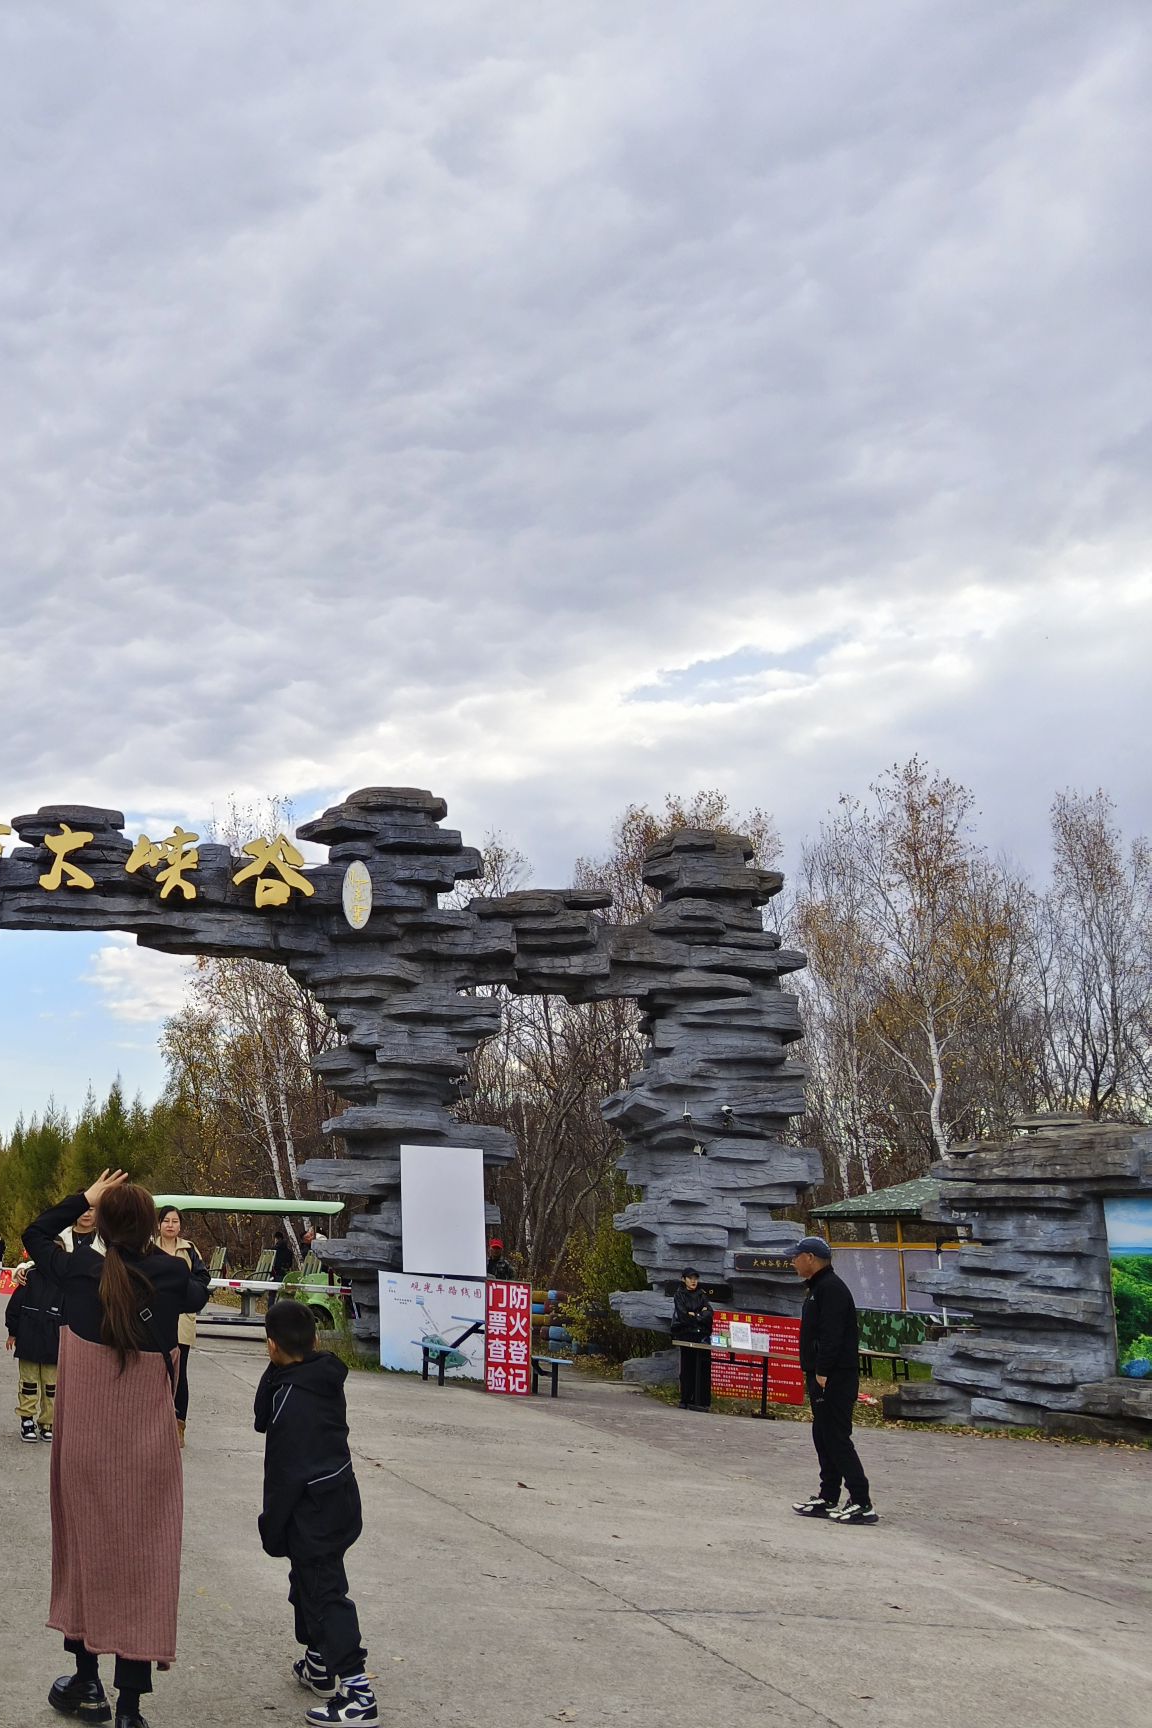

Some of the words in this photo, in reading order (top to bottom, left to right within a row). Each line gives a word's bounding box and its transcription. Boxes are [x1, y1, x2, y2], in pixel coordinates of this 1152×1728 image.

[410, 1281, 482, 1299] 观光车路线图
[487, 1282, 508, 1391] 门票查验
[507, 1284, 529, 1393] 防火登记
